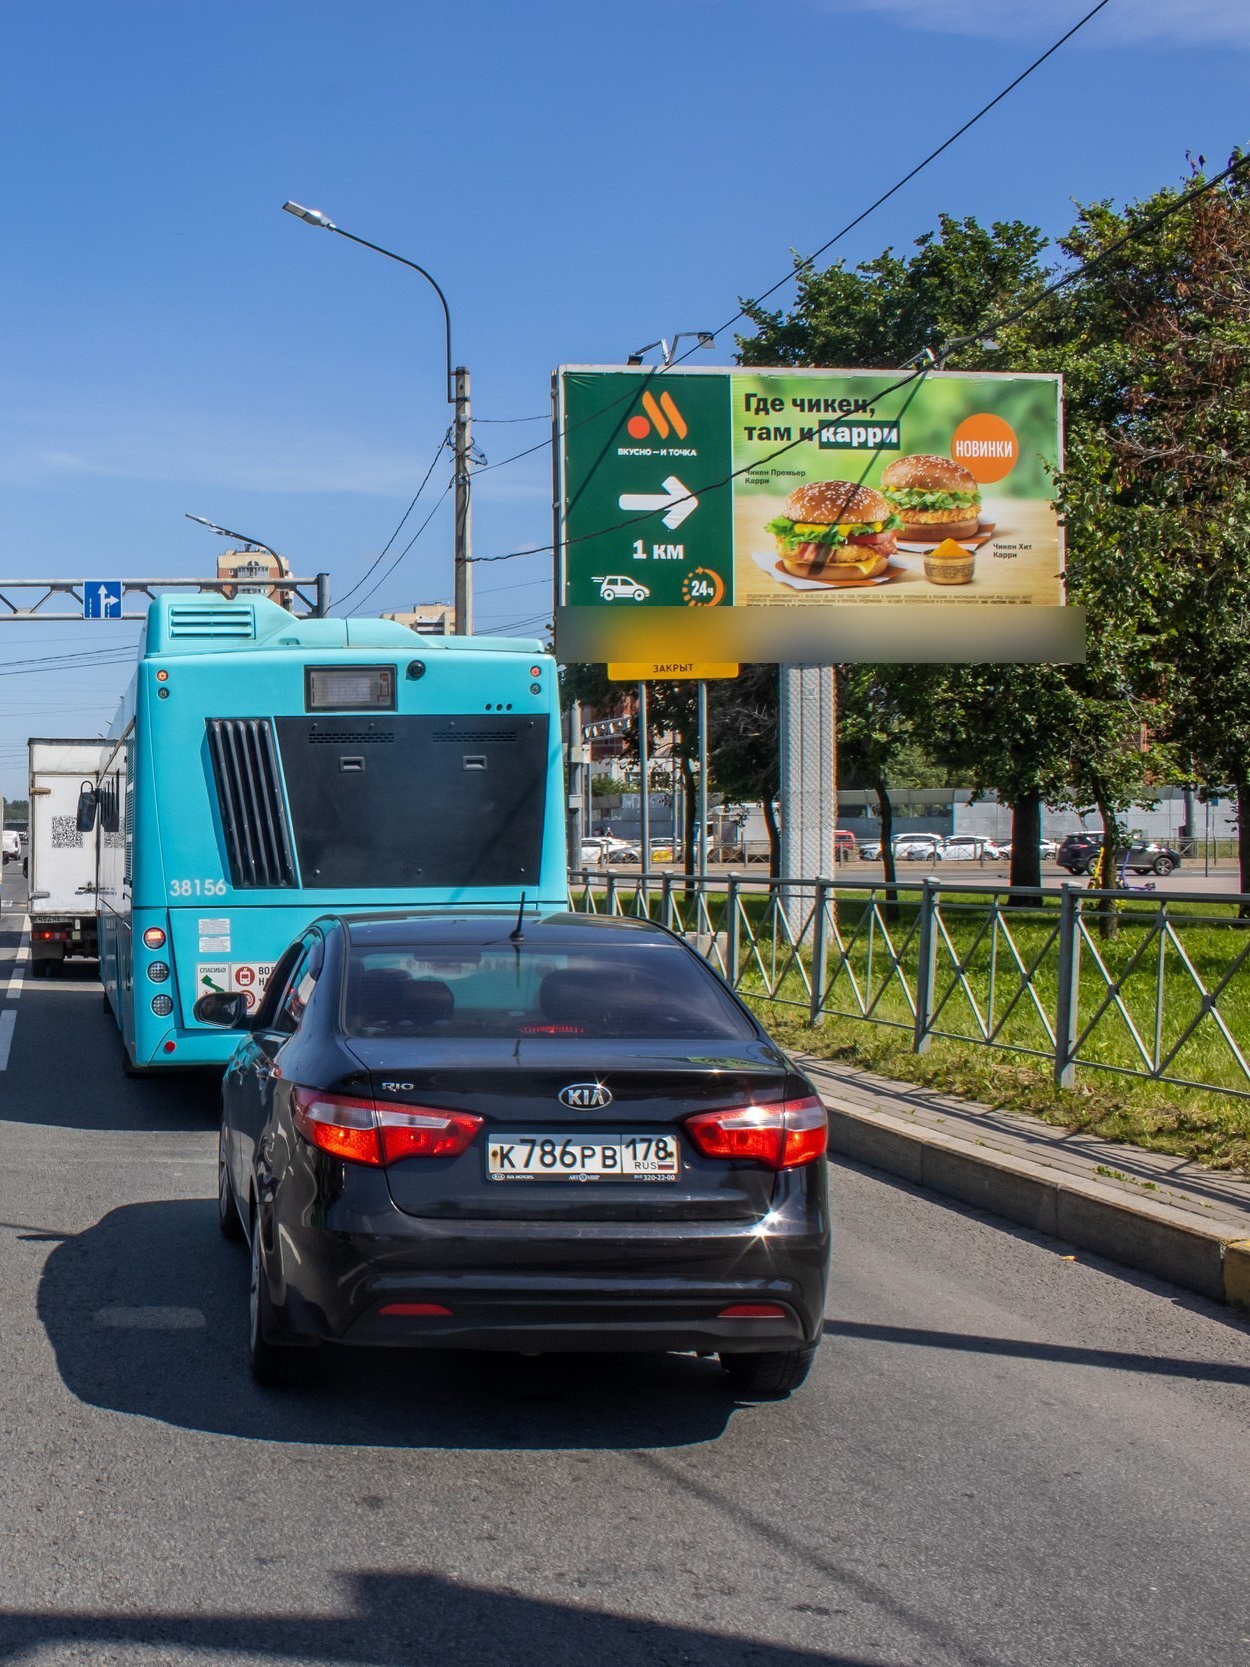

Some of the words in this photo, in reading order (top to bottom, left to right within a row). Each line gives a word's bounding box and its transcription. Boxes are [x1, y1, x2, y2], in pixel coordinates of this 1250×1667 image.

[744, 393, 785, 415] Где
[792, 397, 876, 418] чикен,
[744, 426, 792, 441] там
[800, 427, 814, 441] и
[820, 426, 898, 446] карри
[617, 448, 652, 456] ВКУСНО
[956, 440, 1013, 457] НОВИНКИ
[744, 477, 770, 485] Карри
[770, 469, 806, 477] Премьер
[632, 539, 647, 559] 1
[652, 663, 694, 673] ЗАКРЫТ
[170, 879, 227, 896] 38156
[381, 1082, 415, 1091] RIO
[567, 1089, 605, 1105] KIA
[624, 1138, 669, 1161] 178
[634, 1161, 658, 1170] RUS
